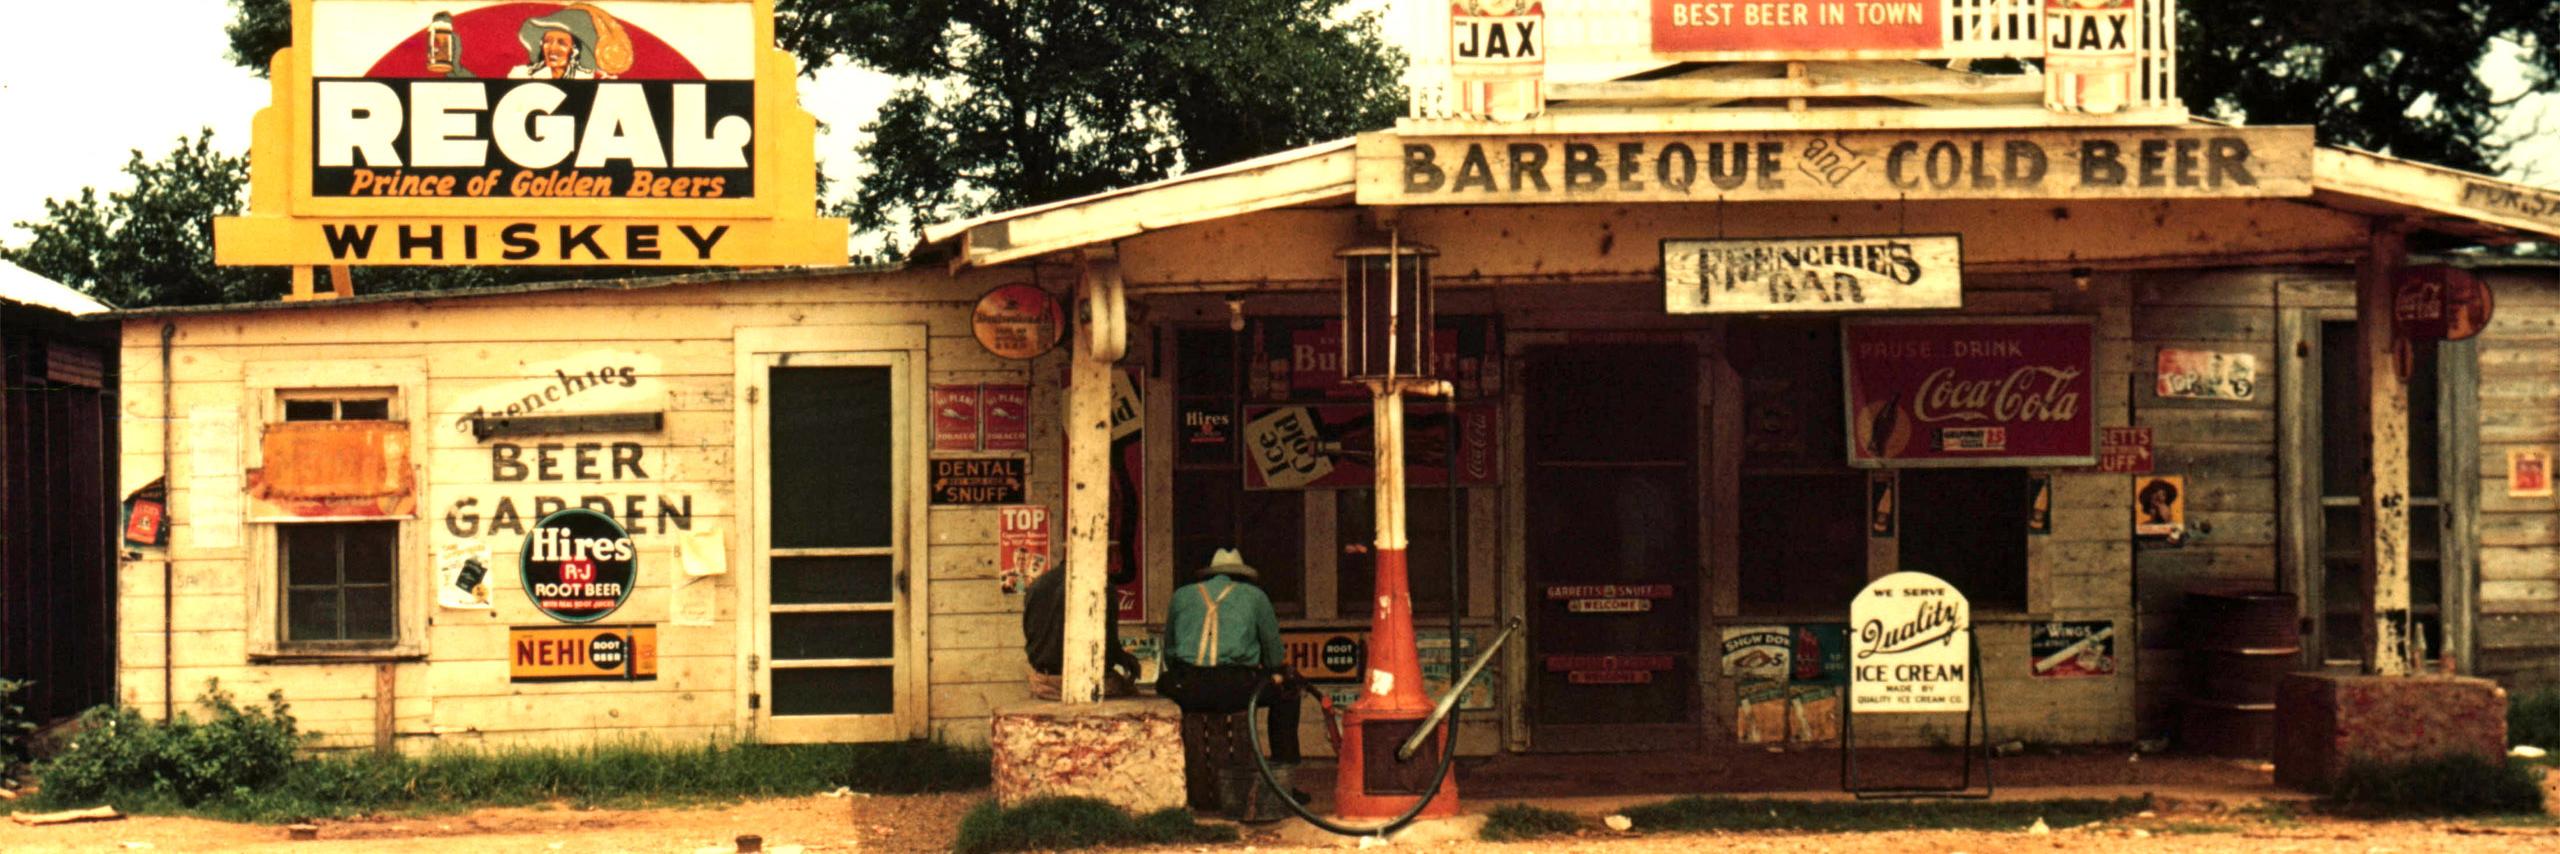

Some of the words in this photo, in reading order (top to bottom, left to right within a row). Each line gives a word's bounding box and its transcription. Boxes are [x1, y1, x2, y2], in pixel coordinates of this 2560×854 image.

[1673, 2, 1732, 26] BEST
[1745, 2, 1808, 26] BEER
[1819, 2, 1844, 26] IN
[1855, 2, 1923, 26] TOWN
[1459, 21, 1535, 58] JAX
[2052, 15, 2127, 50] JAX
[319, 82, 752, 168] REGAL
[1402, 141, 1784, 194] BARBEQUE
[1798, 137, 1866, 188] and
[1886, 139, 2048, 190] COLD
[2079, 137, 2257, 187] BEER
[350, 170, 456, 196] Prince
[467, 170, 504, 196] of
[511, 170, 610, 196] Golden
[627, 171, 725, 197] Beers
[323, 223, 729, 259] WHISKEY
[1769, 271, 1865, 303] BAR
[1860, 341, 1933, 358] PAUSE
[1953, 340, 2023, 358] DRINK
[1914, 365, 2082, 422] Coca-Cola
[1186, 411, 1229, 426] Hires
[1259, 430, 1291, 477] Ice
[1273, 411, 1318, 474] Cold
[492, 441, 650, 482] BEER
[939, 461, 1017, 476] DENTAL
[2103, 455, 2137, 471] UFF
[946, 487, 1008, 502] SNUFF
[1003, 509, 1046, 531] TOP
[531, 527, 632, 561] Hires
[535, 583, 582, 597] ROOT
[585, 583, 621, 597] BEER
[1874, 589, 1892, 597] WE
[1903, 588, 1945, 597] SERVE
[1584, 601, 1636, 609] WELCOME
[1858, 601, 1961, 659] Quality
[2047, 624, 2092, 637] WINGS
[517, 639, 584, 666] NEHI
[593, 641, 620, 650] ROOT
[1326, 645, 1352, 654] ROOT
[1726, 635, 1762, 650] SHOW
[593, 653, 621, 662] BEER
[1285, 643, 1318, 668] HI
[1326, 656, 1353, 665] BEER
[1856, 665, 1888, 682] ICE
[1895, 665, 1963, 682] CREAM
[1858, 696, 1891, 704] QUALITY
